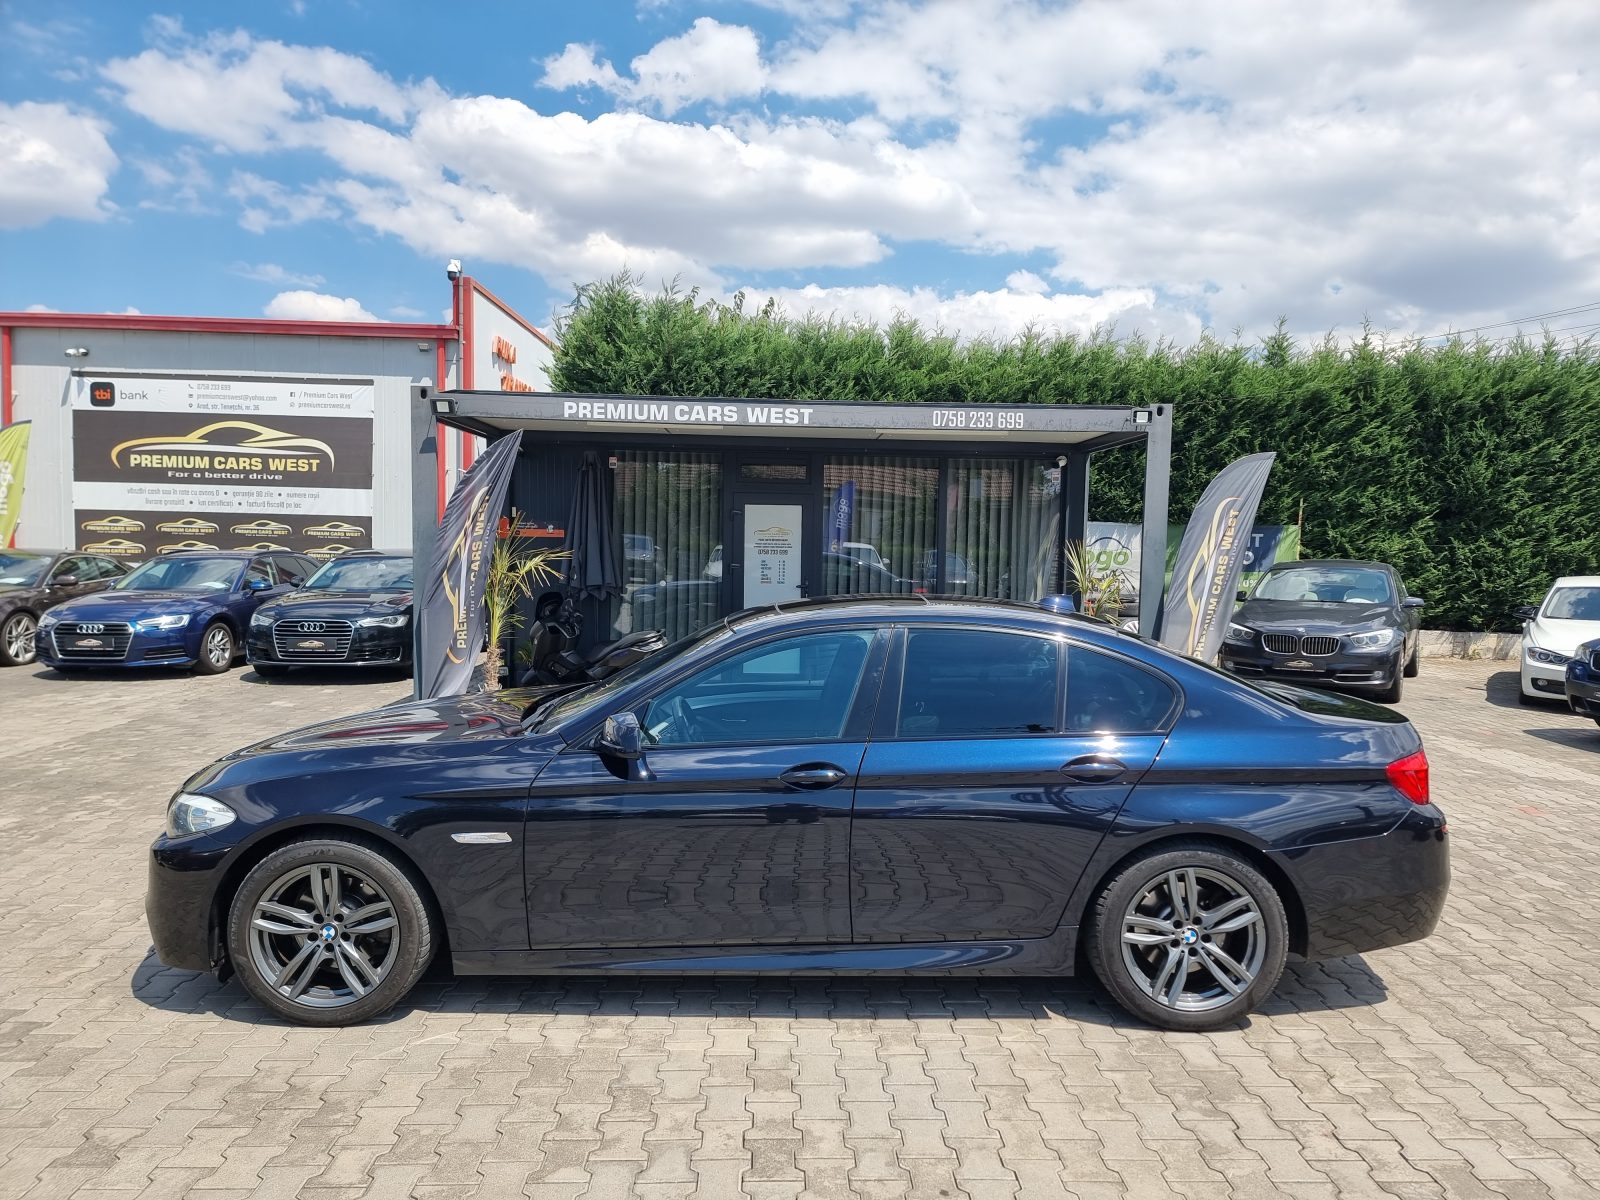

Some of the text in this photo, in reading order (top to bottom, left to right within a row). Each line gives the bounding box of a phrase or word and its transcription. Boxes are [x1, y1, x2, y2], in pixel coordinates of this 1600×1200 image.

[94, 389, 149, 401] tbi bank
[303, 391, 326, 400] Premium
[563, 401, 814, 425] PREMIUM CARS WEST
[932, 410, 1024, 429] 0758 233 699
[129, 454, 321, 472] PREMIUM CARS WEST
[167, 470, 191, 478] For
[204, 471, 245, 480] better
[248, 472, 283, 481] drive
[1211, 555, 1229, 595] CARS
[1220, 508, 1240, 550] WEST
